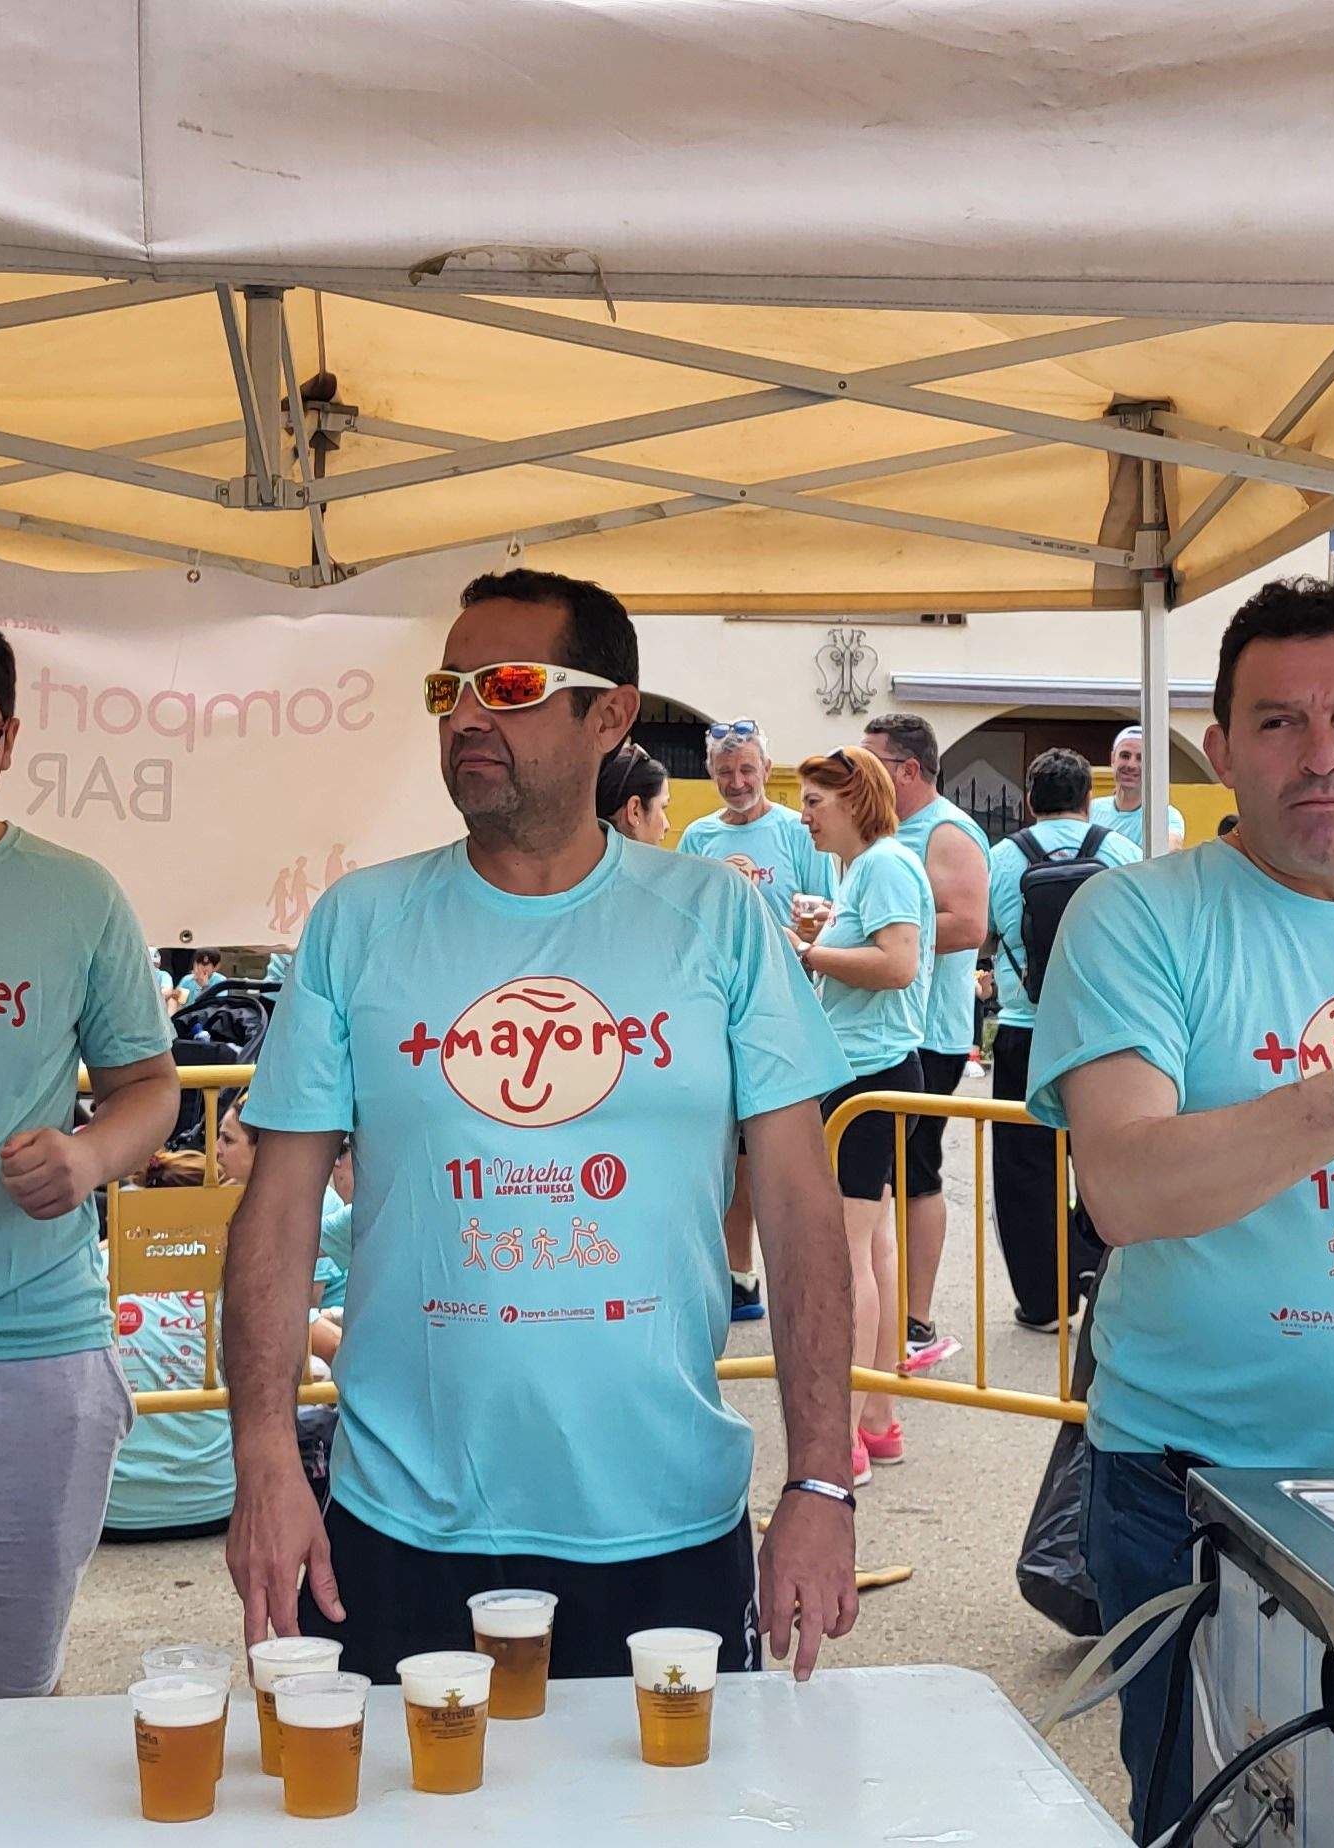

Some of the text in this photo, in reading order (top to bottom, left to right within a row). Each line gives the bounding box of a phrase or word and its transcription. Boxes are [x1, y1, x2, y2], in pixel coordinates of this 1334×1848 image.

[494, 1158, 575, 1184] Marcha
[495, 1184, 575, 1195] ASPACE HUESCA
[550, 1194, 575, 1203] 2023
